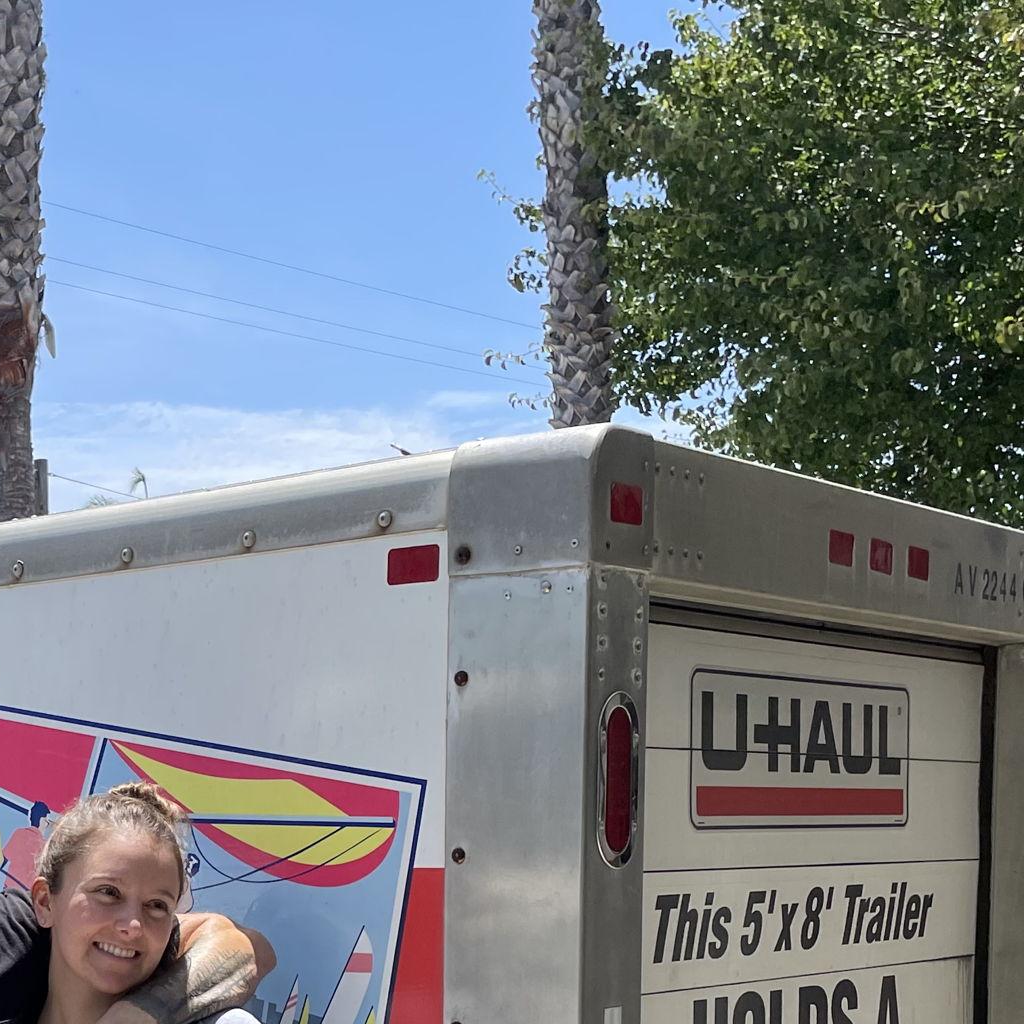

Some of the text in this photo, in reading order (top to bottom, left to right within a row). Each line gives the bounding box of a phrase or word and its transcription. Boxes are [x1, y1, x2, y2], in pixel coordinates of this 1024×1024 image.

[701, 691, 901, 775] U-HAUL
[653, 892, 732, 964] This
[841, 881, 934, 945] Trailer
